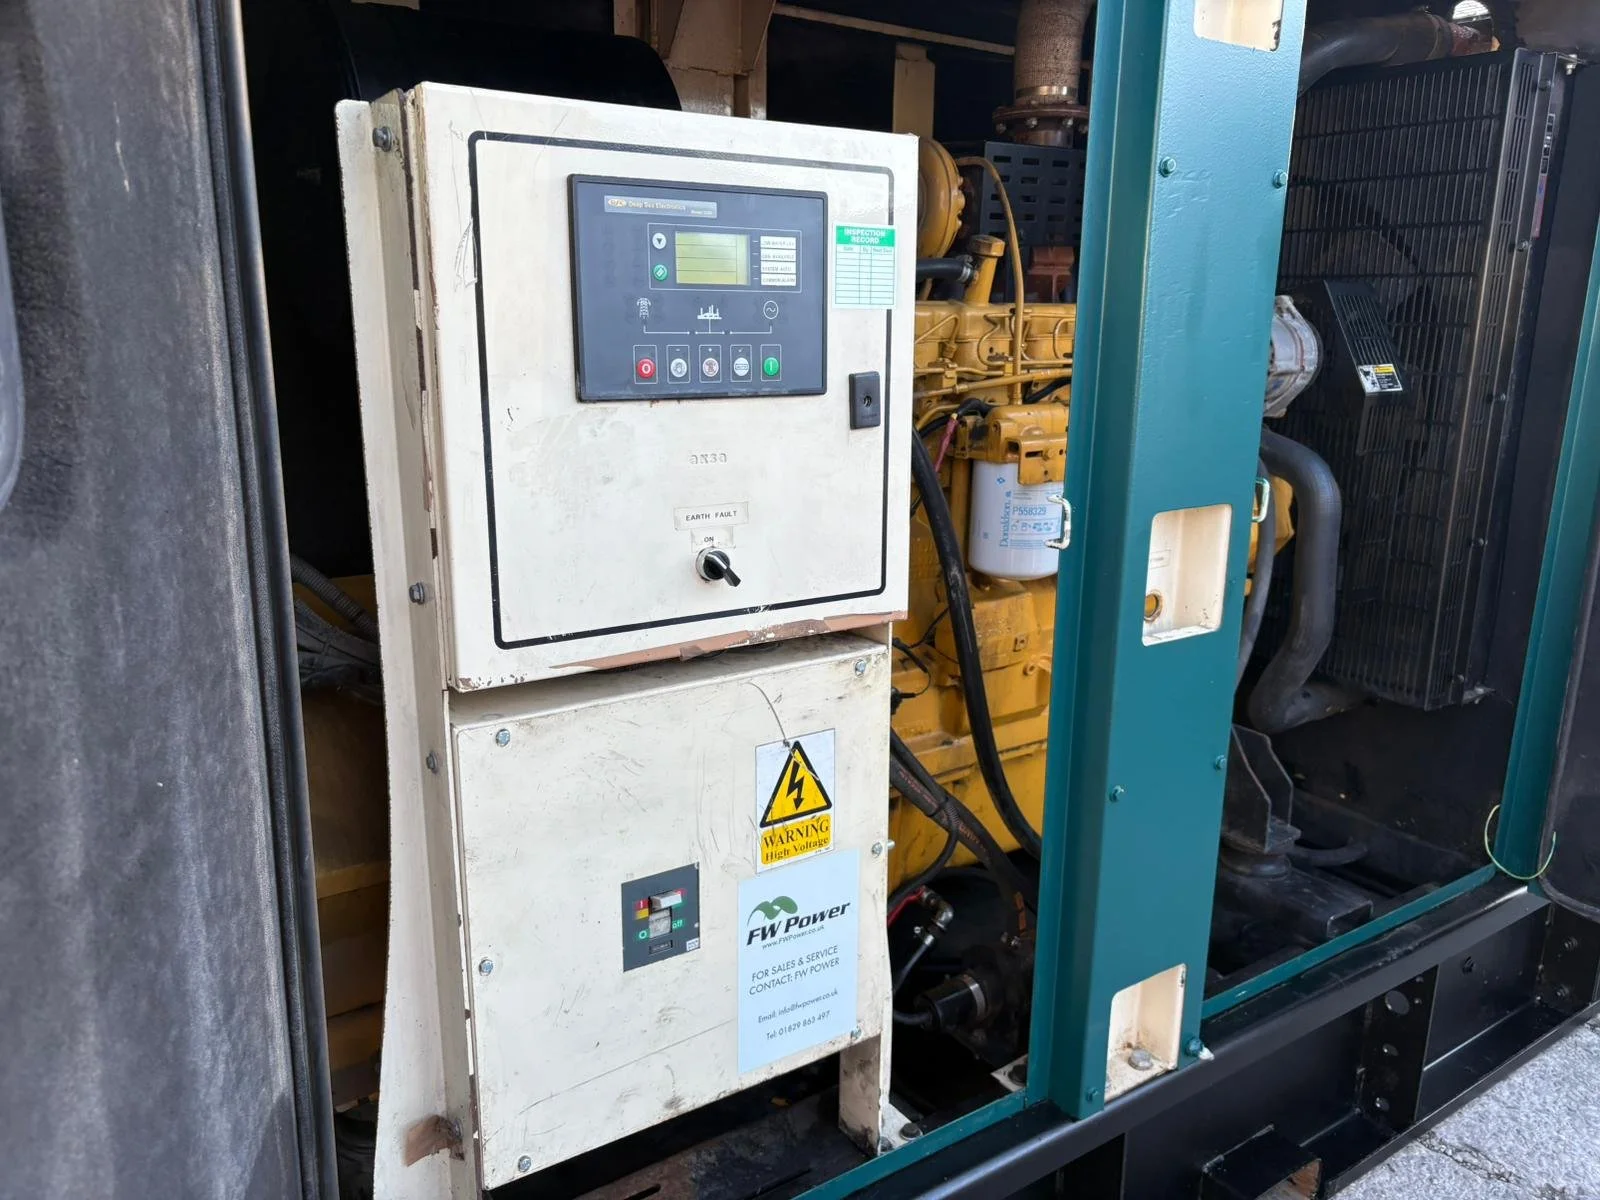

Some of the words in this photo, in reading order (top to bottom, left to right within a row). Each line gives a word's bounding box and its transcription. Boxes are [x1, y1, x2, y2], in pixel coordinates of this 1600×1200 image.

[628, 201, 643, 209] Deep
[655, 203, 686, 211] Electronics
[844, 229, 886, 237] INSPECTION
[851, 236, 880, 244] RECORD
[685, 513, 711, 522] EARTH
[714, 510, 737, 518] FAULT
[1012, 506, 1047, 516] P558329
[763, 819, 830, 849] WARNING
[765, 848, 790, 862] High
[794, 837, 829, 854] Voltage
[672, 919, 683, 929] off
[746, 920, 783, 946] FW
[784, 902, 851, 933] Power
[761, 924, 825, 950] www.FWPower.co.uk
[749, 974, 793, 996] CONTACT:
[794, 967, 810, 982] FW
[809, 957, 840, 976] POWER
[751, 968, 770, 983] FOR
[771, 959, 796, 976] SALES
[797, 956, 805, 967] &
[806, 945, 839, 964] SERVICE
[758, 1011, 778, 1024] Email:
[778, 989, 839, 1017] info@fwpower.co.uk
[766, 1031, 777, 1041] Tel:
[778, 1022, 802, 1037] 01829
[802, 1016, 817, 1028] 863
[816, 1010, 831, 1022] 497
